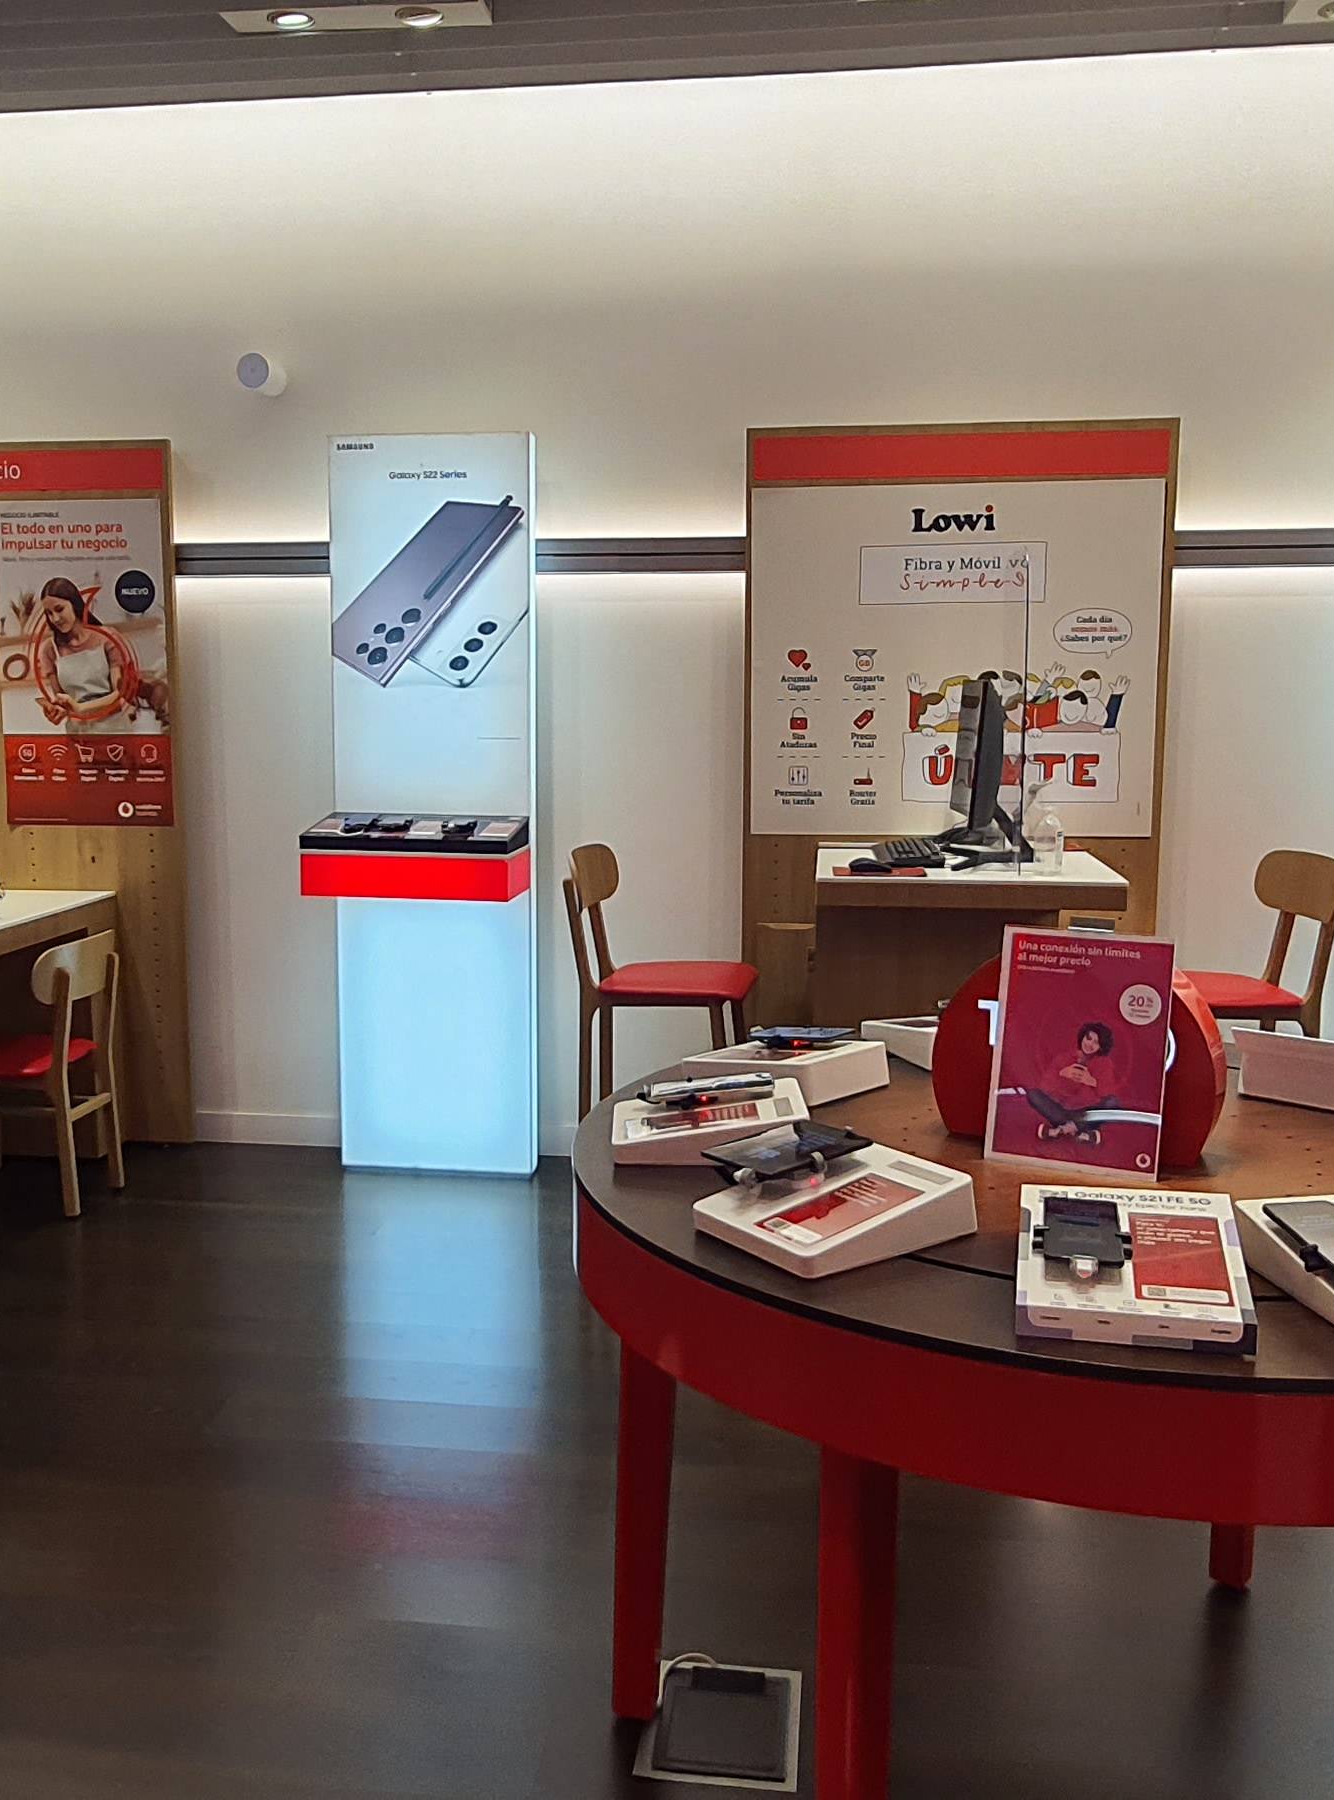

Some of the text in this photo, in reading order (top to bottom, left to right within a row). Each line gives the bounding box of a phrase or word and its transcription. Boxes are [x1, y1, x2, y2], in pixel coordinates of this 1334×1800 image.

[388, 470, 468, 481] Galaxy S22 Series
[910, 504, 996, 533] Lowi
[0, 522, 123, 536] El todo en uno para
[1, 537, 128, 553] impulsar tu negocio
[904, 556, 1002, 573] Fibra y Móvil
[843, 674, 885, 683] Comparte
[1018, 940, 1039, 951] Una
[1087, 946, 1103, 956] sin
[1017, 952, 1092, 967] al mejor precio
[1074, 1191, 1135, 1202] Galaxy
[1137, 1194, 1163, 1203] S21
[1166, 1196, 1184, 1204] FE
[1188, 1198, 1212, 1206] 5G
